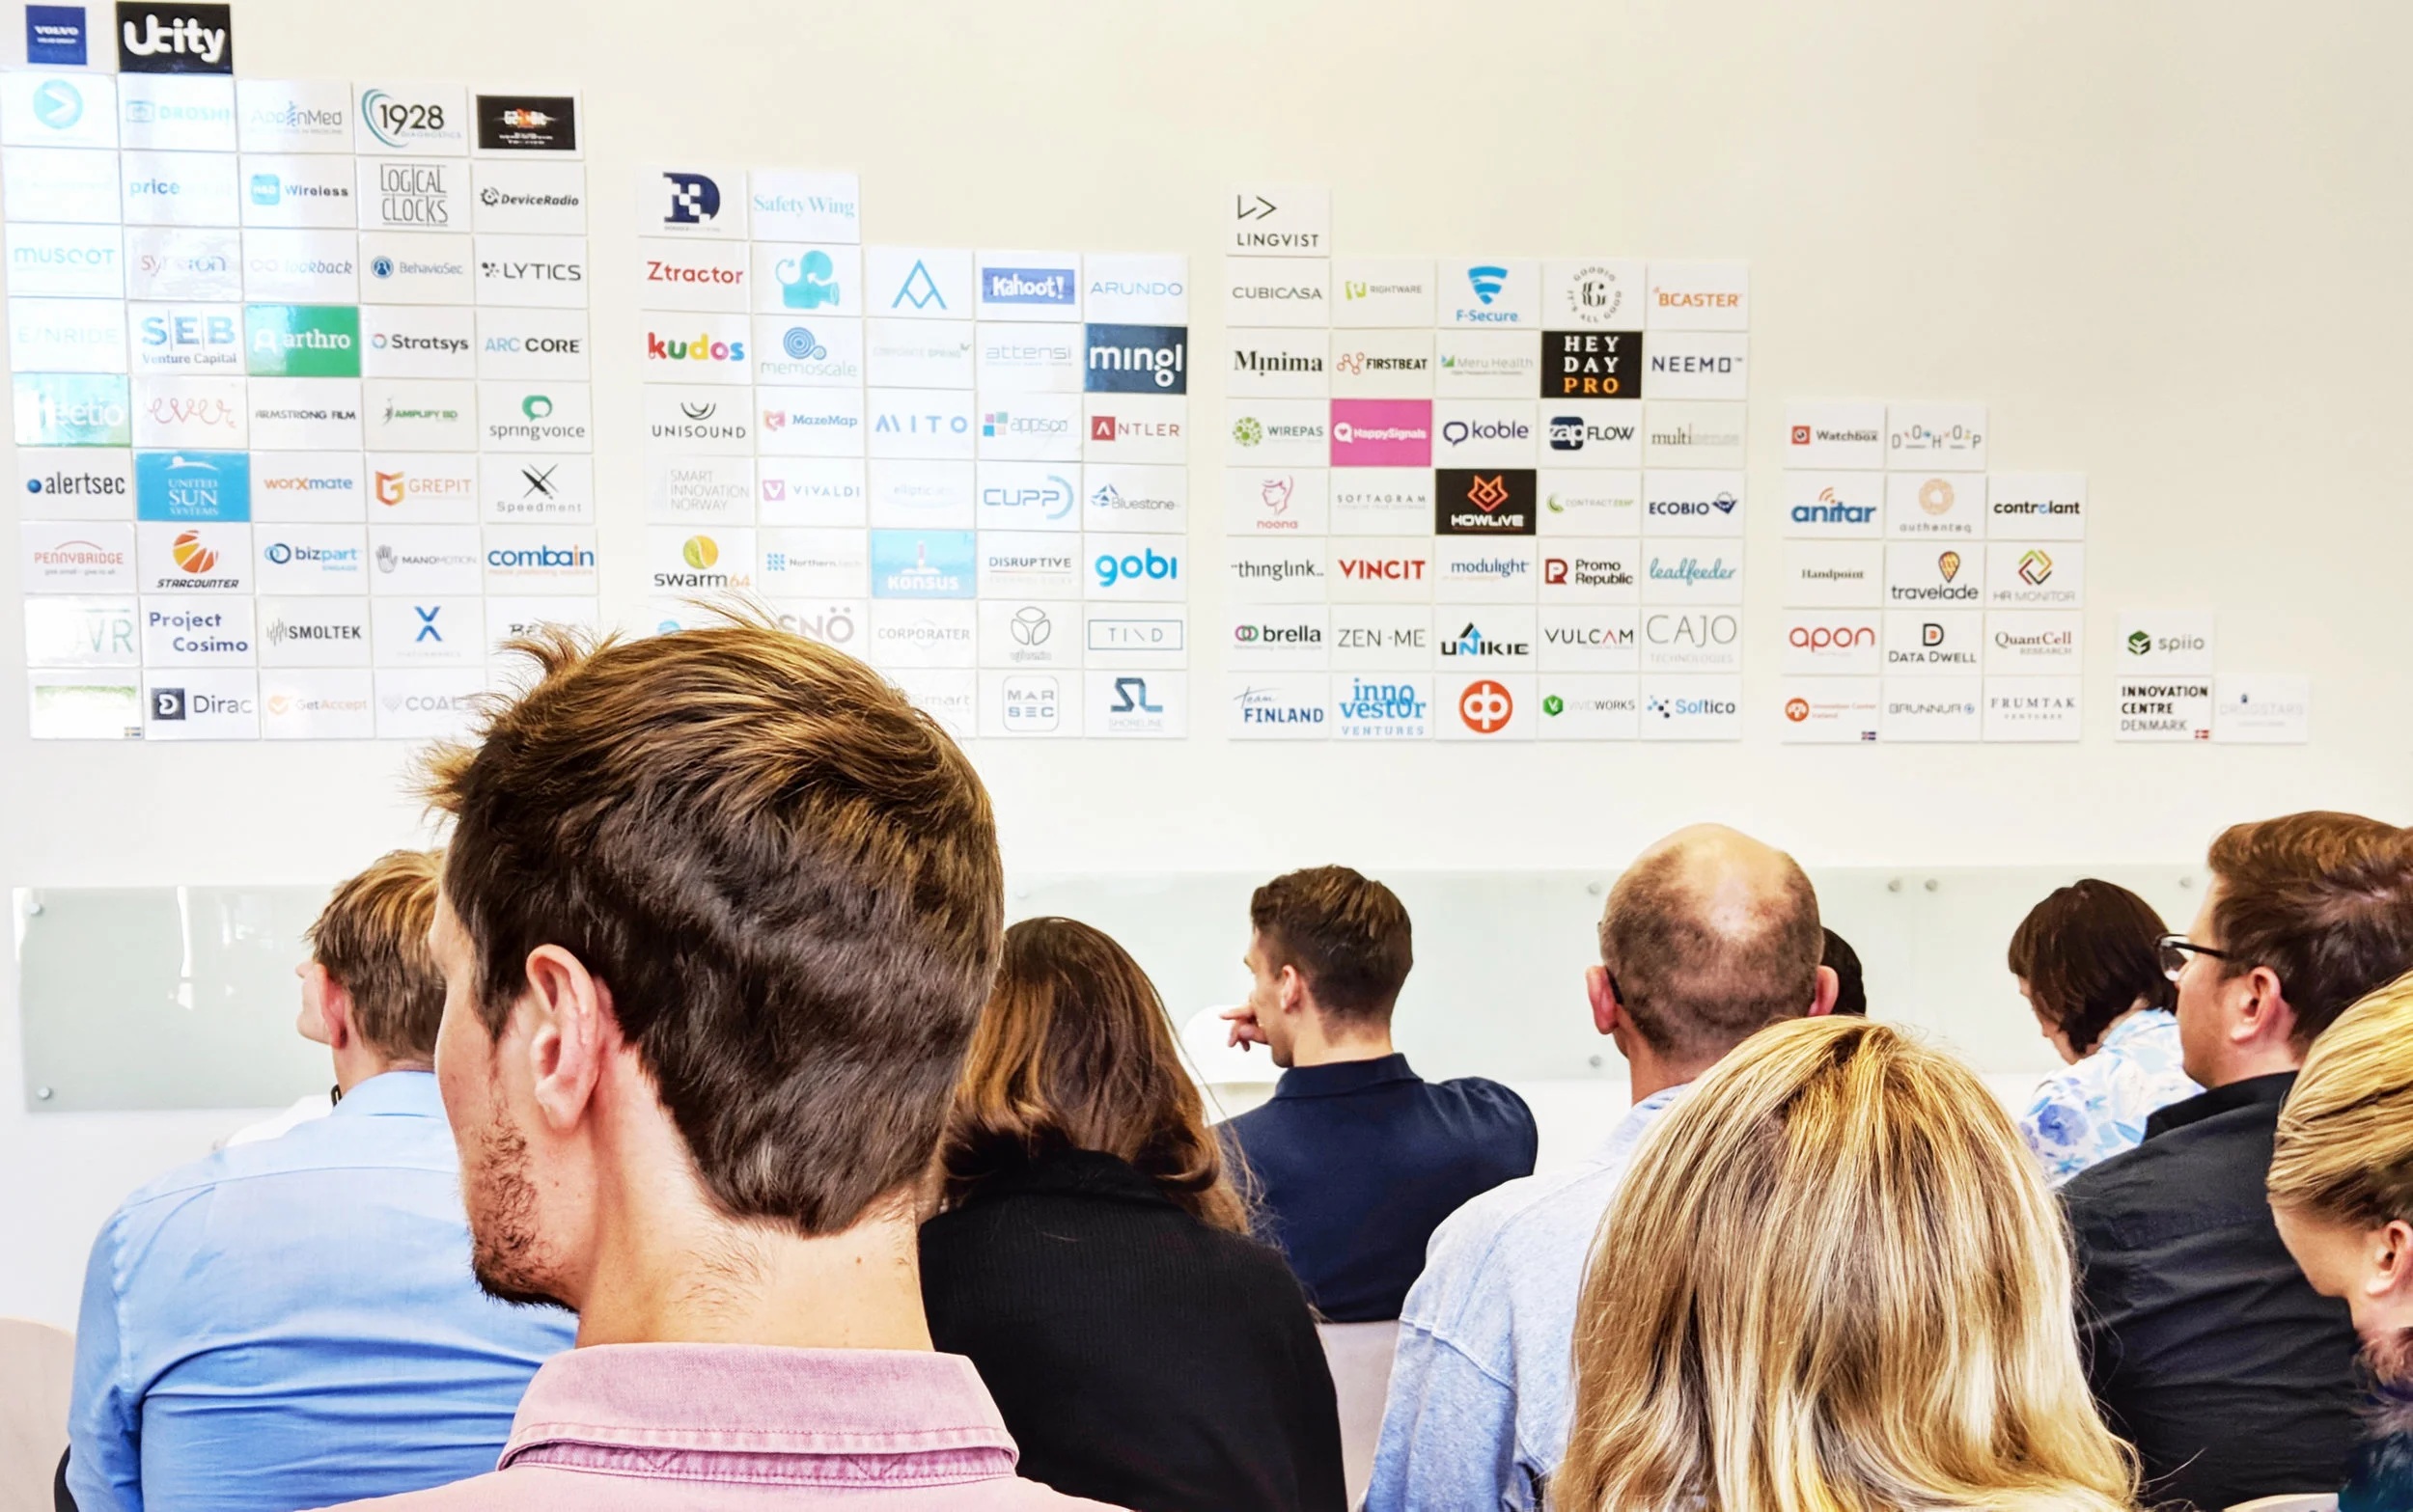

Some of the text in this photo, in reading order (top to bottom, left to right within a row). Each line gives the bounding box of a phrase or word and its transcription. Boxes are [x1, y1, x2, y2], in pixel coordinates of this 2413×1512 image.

[35, 26, 78, 35] VOLVO
[380, 105, 444, 135] 1928
[380, 164, 447, 194] LOGICAL
[286, 185, 348, 196] Wireless
[501, 194, 579, 206] DeviceRadio
[382, 195, 448, 225] CLOCKS
[1236, 234, 1318, 247] LINGVIST
[400, 261, 462, 274] BehavioSec
[503, 262, 581, 281] LYTICS
[647, 261, 743, 285] Ztractor
[992, 274, 1065, 299] Kahoot!
[1091, 282, 1183, 295] ARUNDO
[1232, 288, 1322, 300] CUBICASA
[1456, 309, 1519, 322] F-Secure
[392, 334, 469, 353] Stratsys
[485, 338, 579, 353] ARC CORE
[648, 332, 745, 361] kudos
[1564, 337, 1620, 352] HEY
[142, 353, 237, 365] Venture Capital
[986, 345, 1071, 360] attensi
[761, 361, 857, 377] memoscale
[1367, 358, 1428, 370] FIRSTBEAT
[1491, 355, 1533, 369] Health
[1564, 357, 1620, 372] DAY
[1564, 377, 1620, 394] PRO
[255, 409, 355, 421] ARMSTRONG FILM
[395, 409, 440, 419] AMPLIFY
[792, 415, 857, 428] MazeMap
[1011, 417, 1068, 433] appsco
[652, 426, 745, 438] UNISOUND
[1267, 426, 1324, 437] WIREPAS
[1353, 428, 1427, 440] HappySignals
[1471, 421, 1530, 439] koble
[1817, 429, 1878, 442] Watchbox
[670, 470, 713, 482] SMART
[45, 472, 125, 495] alertsec
[168, 479, 218, 488] UNITED
[409, 479, 471, 493] GREPIT
[168, 490, 218, 506] SUN
[670, 484, 750, 498] INNOVATION
[793, 486, 860, 497] VIVALDI
[983, 489, 1060, 507] CUPP
[670, 499, 728, 511] NORWAY
[1112, 496, 1175, 510] Bluestone
[1337, 495, 1426, 504] SOFTAGRAM
[497, 502, 581, 512] Speedment
[1649, 502, 1709, 515] ECOBIO
[1790, 500, 1876, 524] anitar
[1451, 513, 1524, 528] HOWLIVE
[1899, 522, 1972, 534] authenteq
[35, 552, 124, 564] PENNYBRIDGE
[295, 547, 358, 563] bizpart
[402, 556, 477, 564] MANOMOTION
[487, 544, 595, 567] combain
[988, 556, 1071, 568] DISRUPTIVE
[1095, 548, 1178, 587] gobi
[1338, 560, 1426, 580] VINCIT
[1451, 558, 1527, 578] modulight
[1575, 561, 1621, 571] Promo
[1650, 558, 1736, 586] leadfeeder
[1575, 573, 1633, 587] Republic
[1802, 569, 1864, 581] Handpoint
[156, 579, 239, 589] STARCOUNTER
[1892, 585, 1979, 600] travelade
[1993, 591, 2075, 601] HR MONITOR
[149, 612, 222, 632] Project
[289, 626, 361, 639] SMOLTEK
[877, 627, 970, 641] CORPORATER
[1262, 625, 1321, 643] brella
[1544, 629, 1633, 644] VULCAM
[1647, 615, 1737, 648] CAJO
[173, 636, 249, 652] Cosimo
[1789, 627, 1875, 652] apon
[1995, 631, 2072, 648] QuantCell
[2158, 634, 2205, 653] spiio
[1650, 653, 1733, 664] TECHNOLOGIES
[1889, 651, 1977, 663] DATA DWELL
[1008, 690, 1054, 701] MAR
[1353, 677, 1415, 703] inno
[2122, 686, 2208, 698] INNOVATION
[193, 695, 253, 714] Dirac
[1676, 699, 1735, 714] Softico
[1990, 698, 2075, 708] FRUMTAK
[2122, 702, 2174, 714] CENTRE
[1008, 706, 1054, 718] SEC
[1244, 708, 1324, 724] FINLAND
[1340, 701, 1427, 720] vestor
[1342, 726, 1425, 735] VENTURES
[2122, 720, 2187, 731] DENMARK
